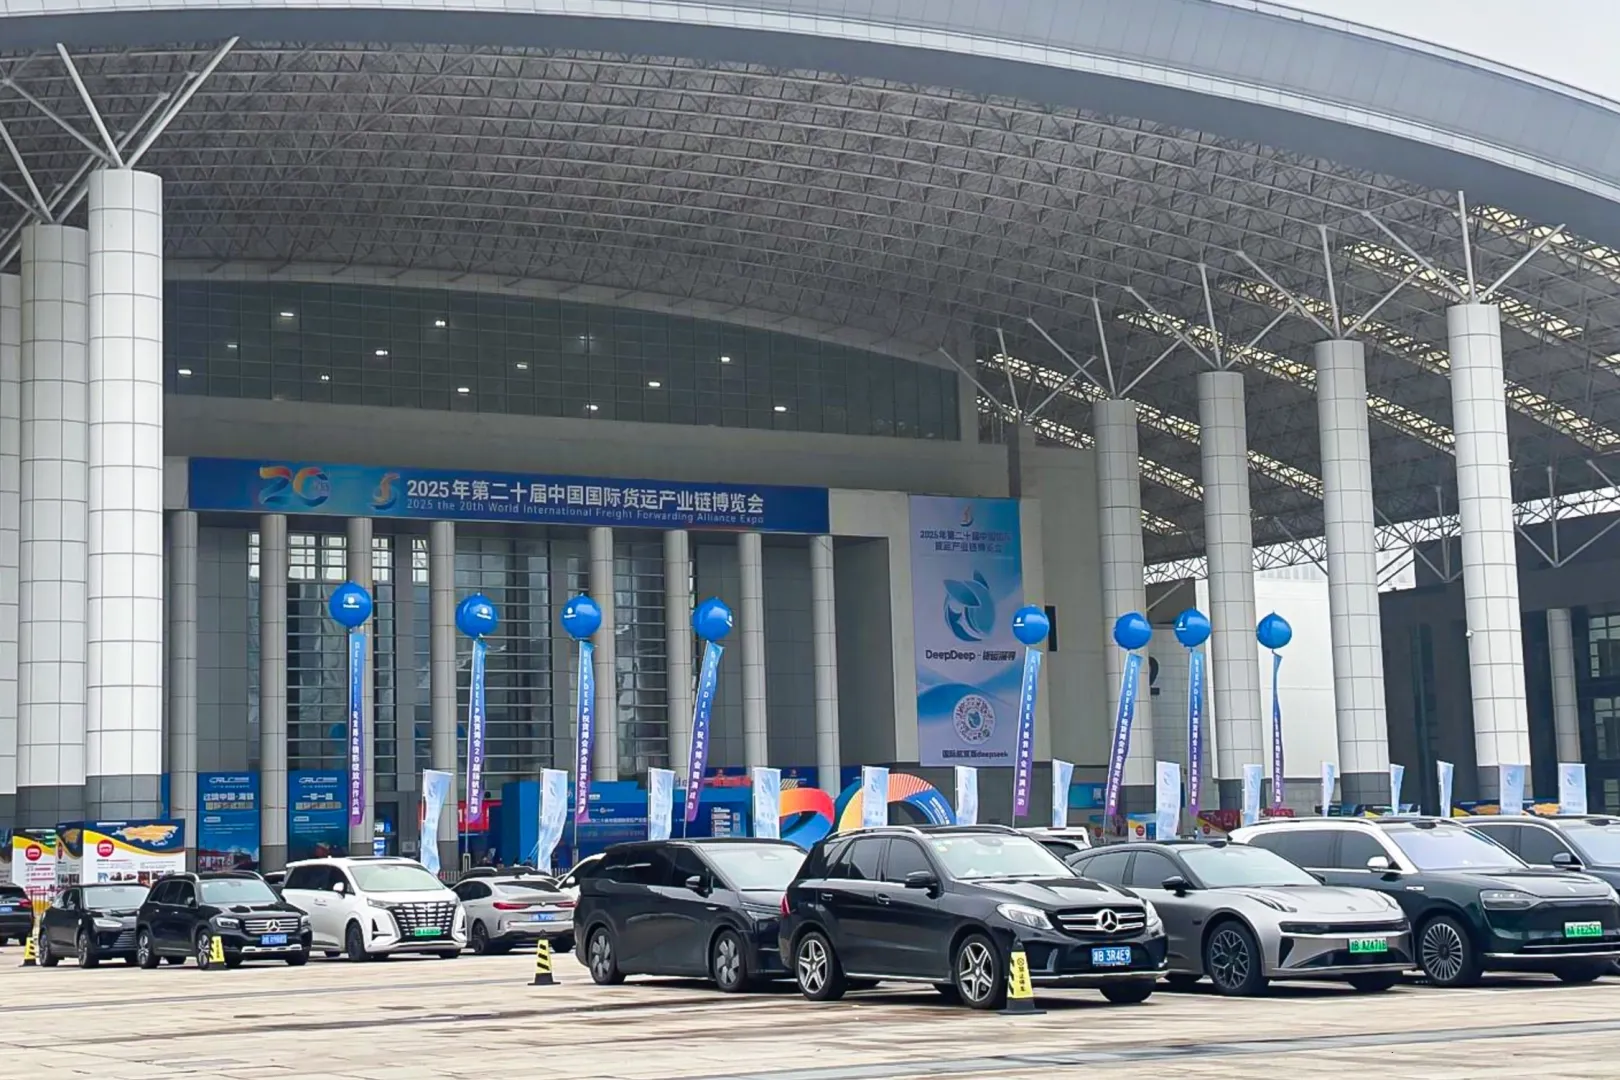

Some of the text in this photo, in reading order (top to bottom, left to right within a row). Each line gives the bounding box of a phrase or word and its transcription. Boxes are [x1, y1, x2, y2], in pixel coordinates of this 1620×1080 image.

[406, 479, 764, 514] 2025年第二十届中国国际货运产业链博览会
[407, 499, 764, 525] 2025 the 20th World International Freight Forwarding Alliance Expo
[925, 649, 976, 661] DeepDeep
